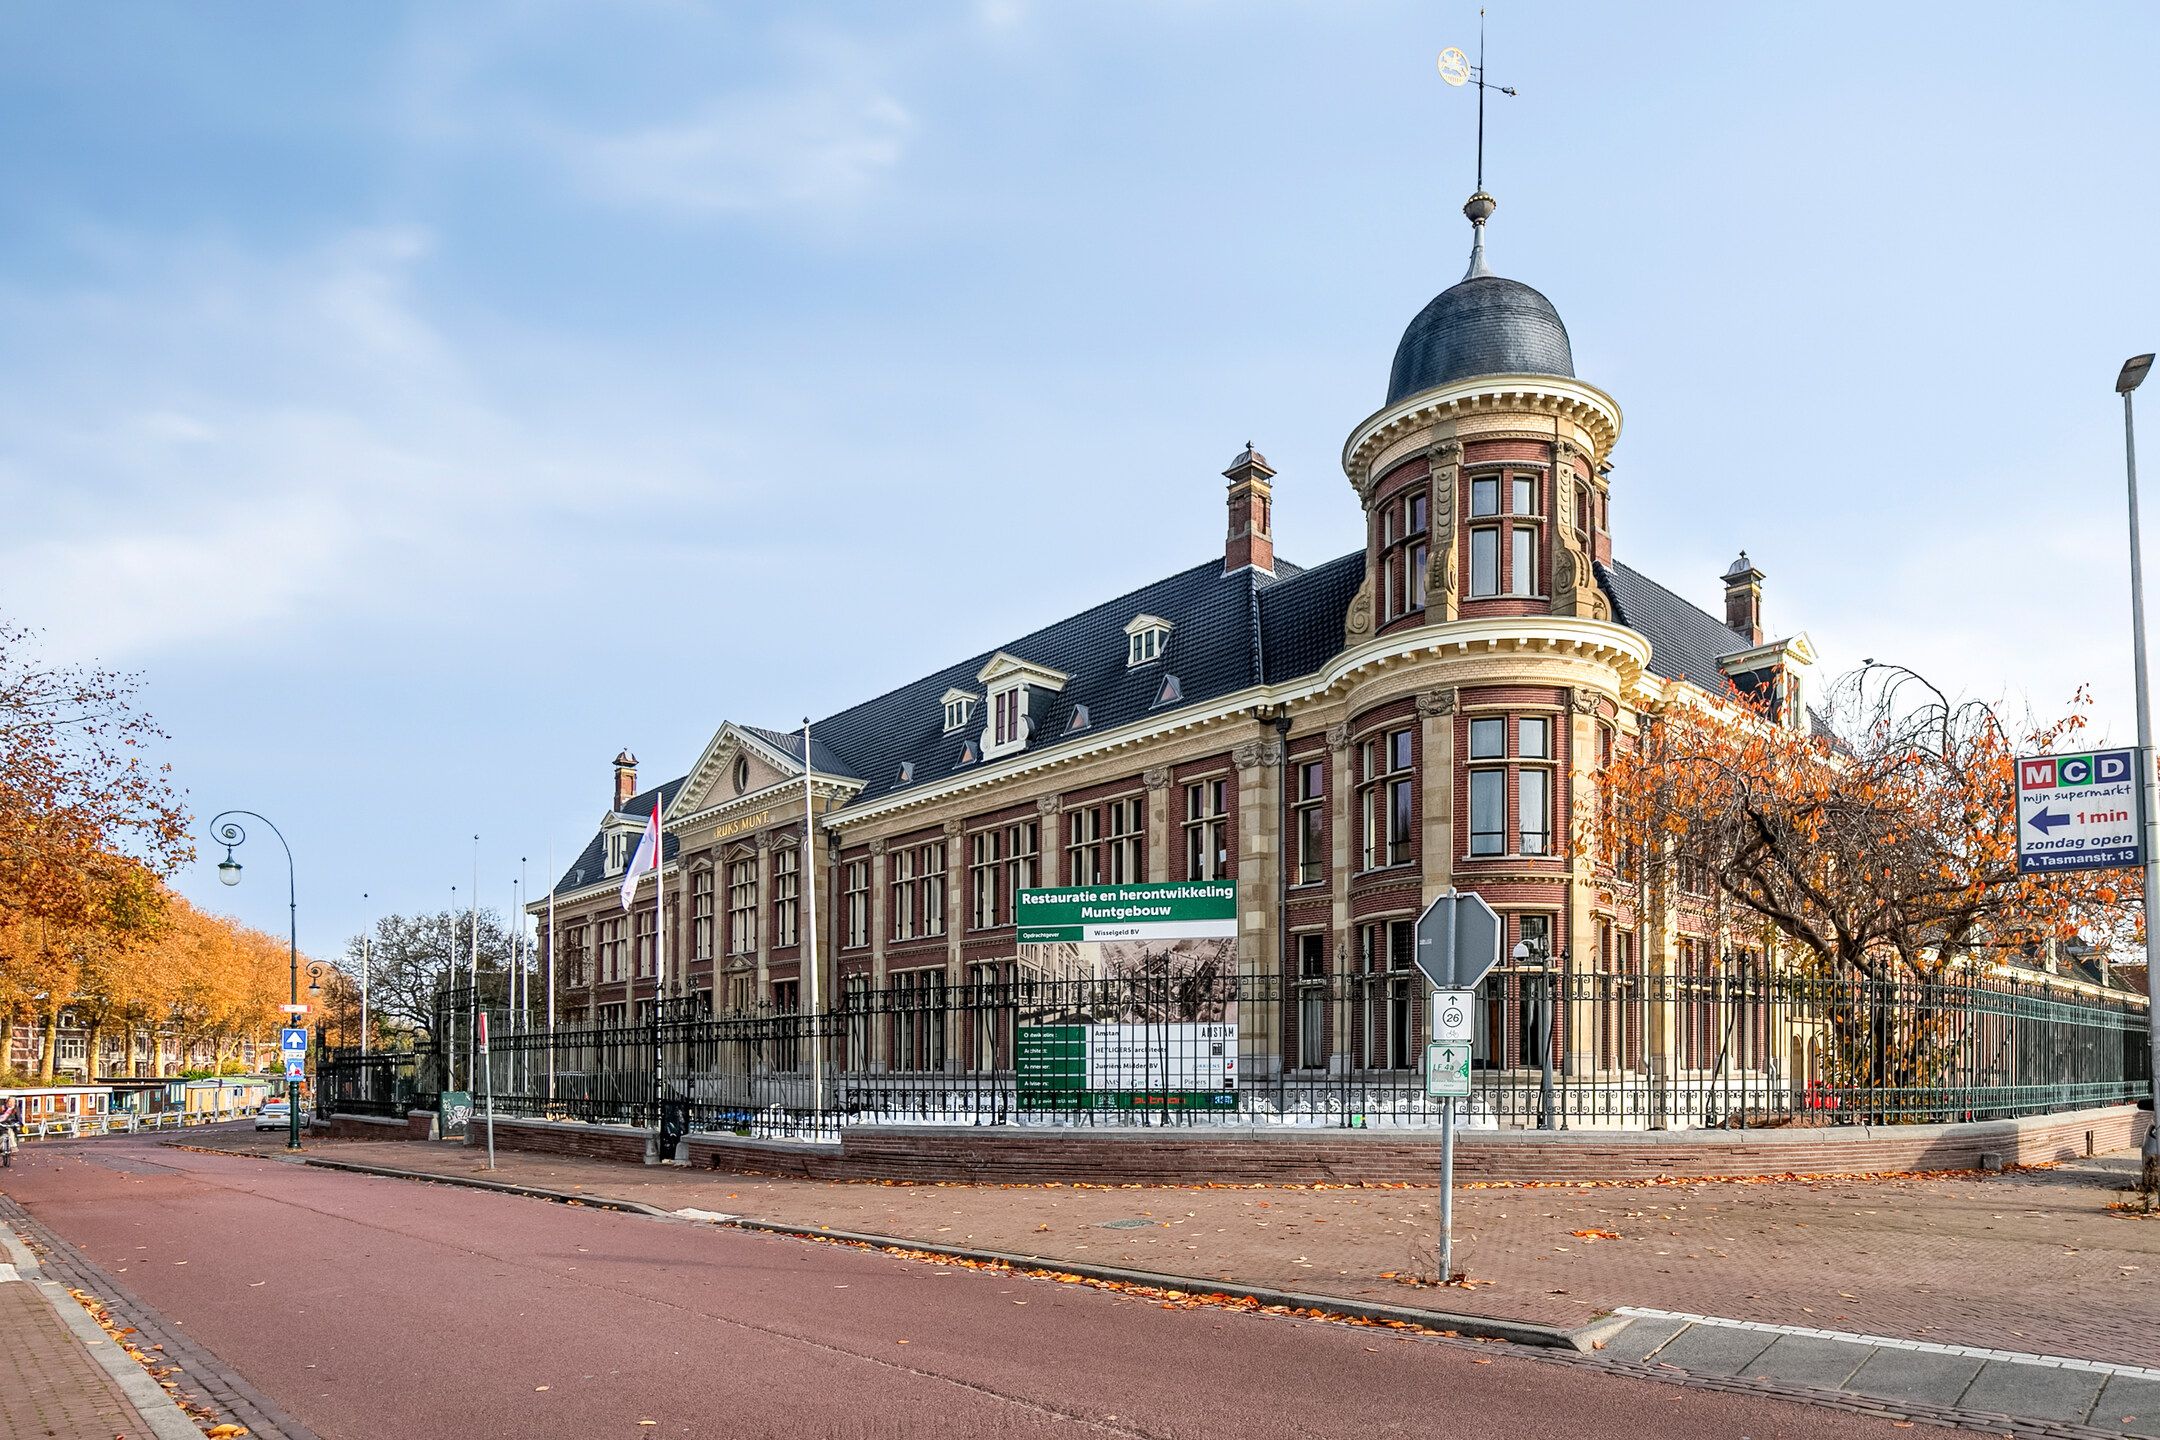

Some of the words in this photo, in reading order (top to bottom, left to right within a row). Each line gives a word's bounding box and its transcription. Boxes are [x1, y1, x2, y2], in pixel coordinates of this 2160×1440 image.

[2026, 758, 2124, 785] MCD
[2023, 793, 2050, 804] mijn
[2054, 785, 2132, 803] supermarkt
[2076, 812, 2085, 824] 1
[2090, 810, 2129, 824] min
[2026, 837, 2085, 851] zondag
[2091, 834, 2133, 848] open
[2118, 851, 2135, 861] 13
[1022, 890, 1097, 905] Restauratie
[1100, 892, 1117, 902] en
[1119, 886, 1234, 902] herontwikkeling
[1081, 904, 1172, 919] Muntgebouw
[1094, 929, 1129, 937] Wisselgeld
[1446, 1013, 1460, 1022] 26
